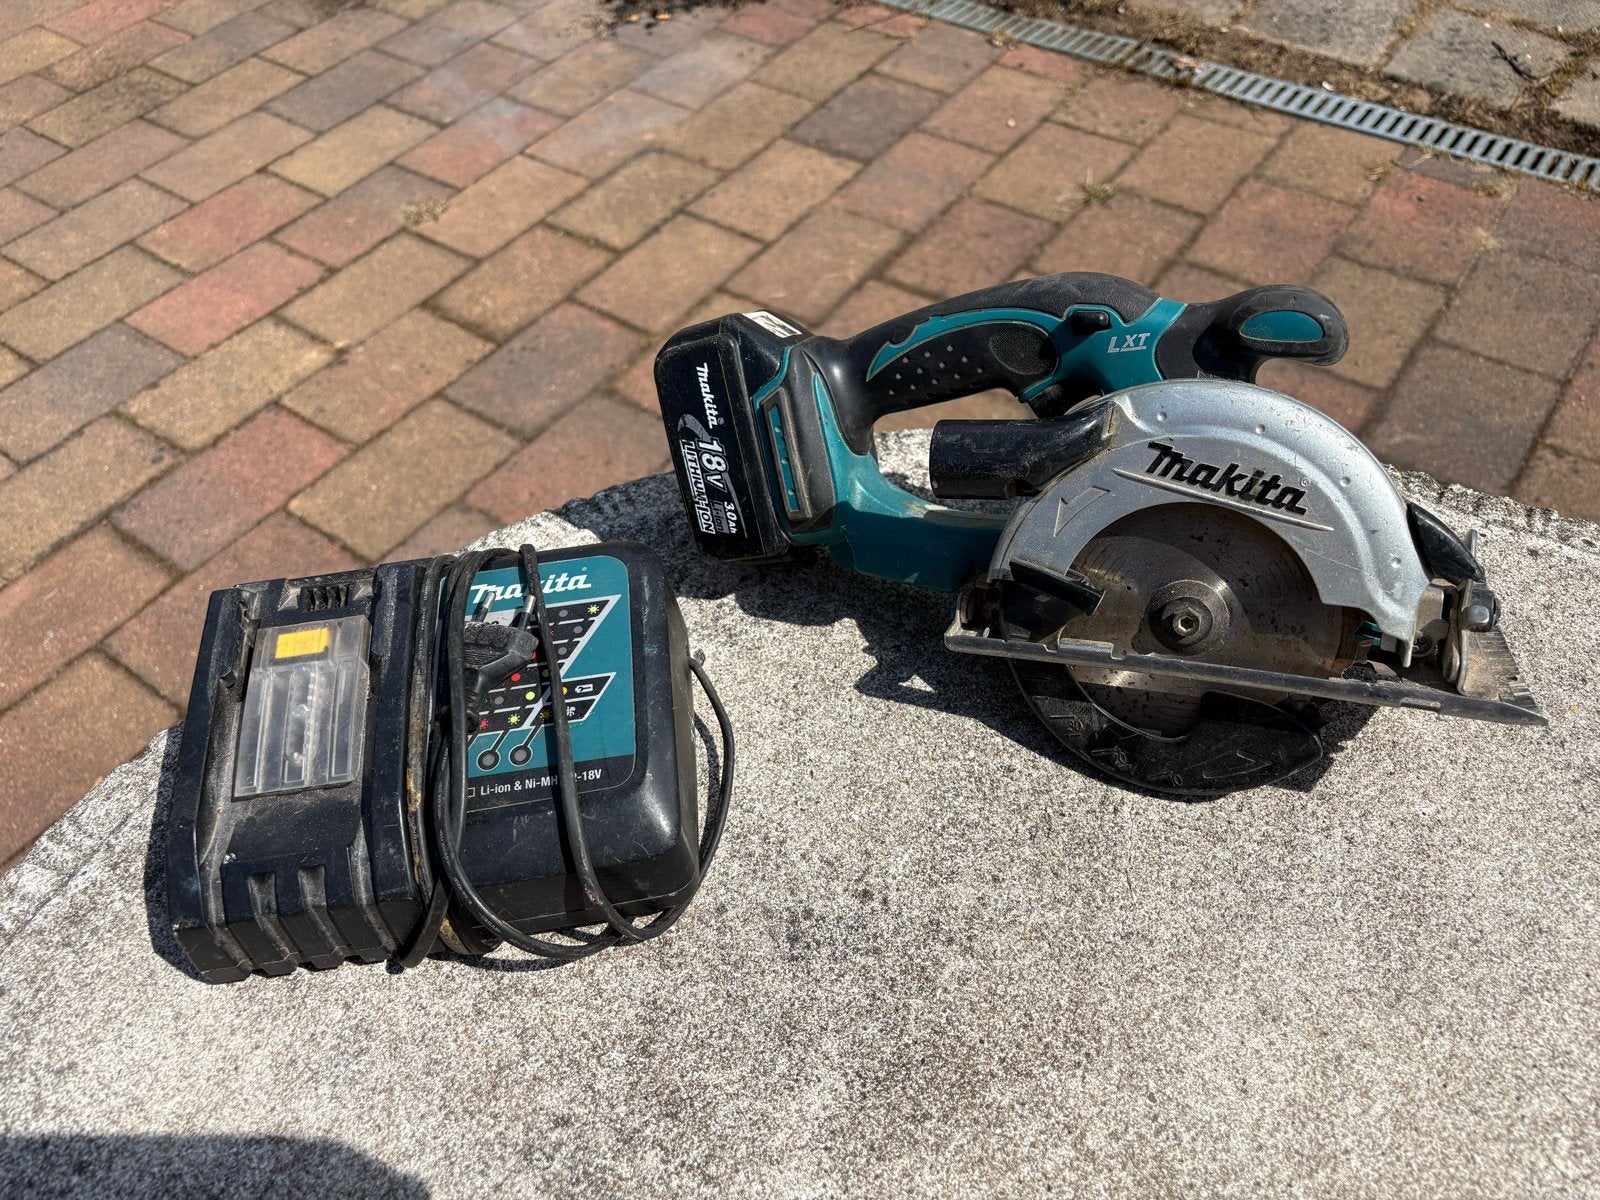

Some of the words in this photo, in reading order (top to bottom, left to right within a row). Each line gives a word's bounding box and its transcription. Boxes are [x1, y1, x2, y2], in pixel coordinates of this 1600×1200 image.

[1107, 333, 1150, 354] LXT
[698, 438, 727, 493] 18V
[680, 440, 716, 534] LITHIUM-ION
[712, 501, 725, 532] Li-ion
[724, 501, 737, 533] 3.0Ah
[470, 572, 592, 604] Maita
[480, 783, 511, 796] Li-ion
[513, 780, 523, 791] &
[525, 775, 558, 789] Ni-MH
